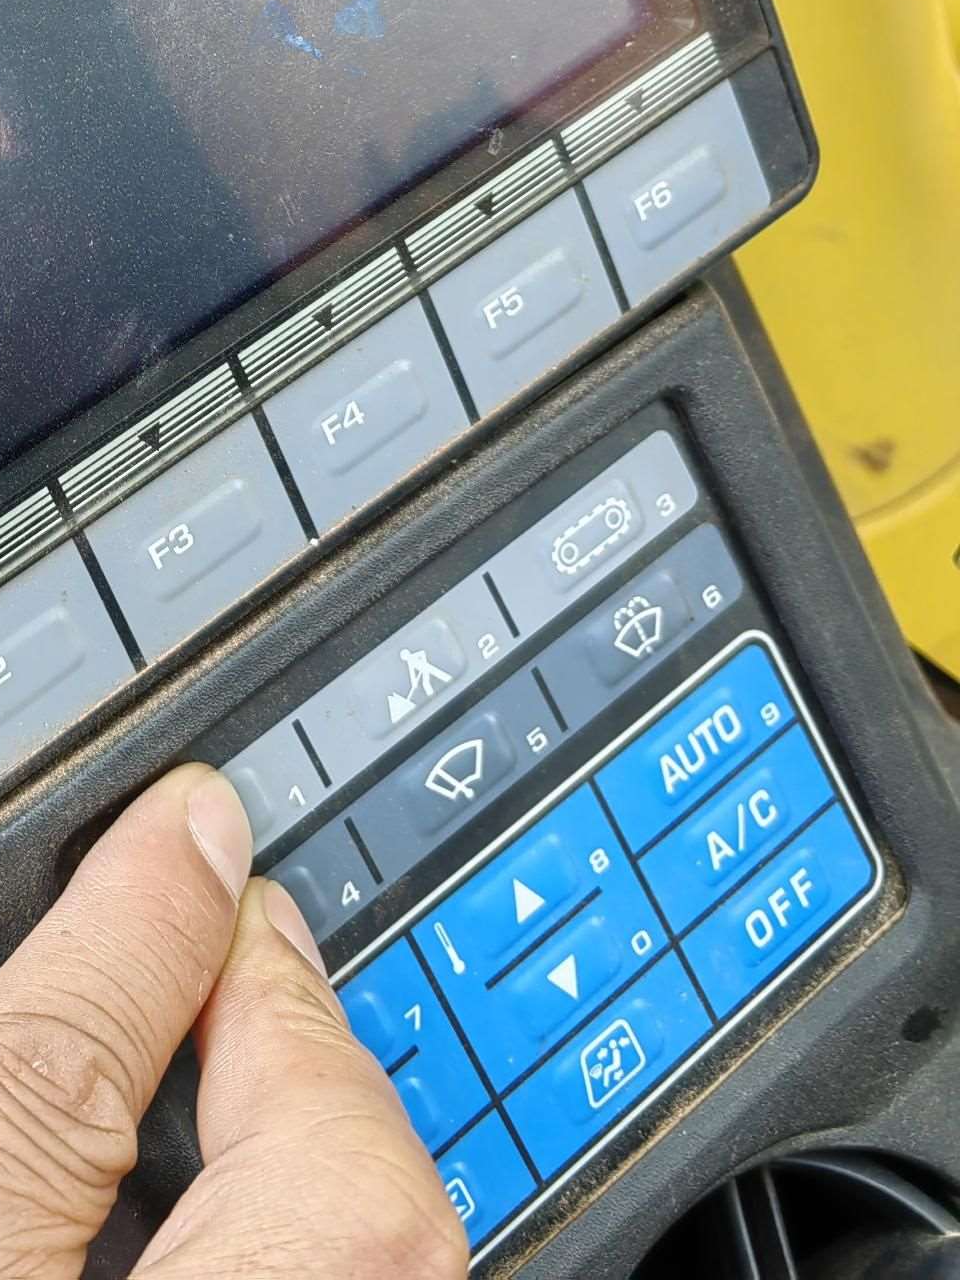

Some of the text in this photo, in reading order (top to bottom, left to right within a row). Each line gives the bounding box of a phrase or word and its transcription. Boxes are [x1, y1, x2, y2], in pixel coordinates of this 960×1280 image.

[633, 181, 672, 222] F6
[483, 286, 524, 330] F5
[320, 401, 365, 444] F4
[656, 492, 675, 516] 3
[148, 524, 194, 570] F3
[702, 583, 723, 609] 6
[476, 632, 501, 660] 2
[761, 702, 781, 726] 9
[526, 728, 548, 754] 5
[659, 704, 741, 793] AUTO
[288, 784, 308, 809] 1
[705, 788, 777, 870] A/C
[588, 848, 610, 874] 8
[339, 879, 362, 907] 4
[744, 868, 814, 948] OFF
[631, 929, 654, 956] 0
[403, 1003, 425, 1031] 7
